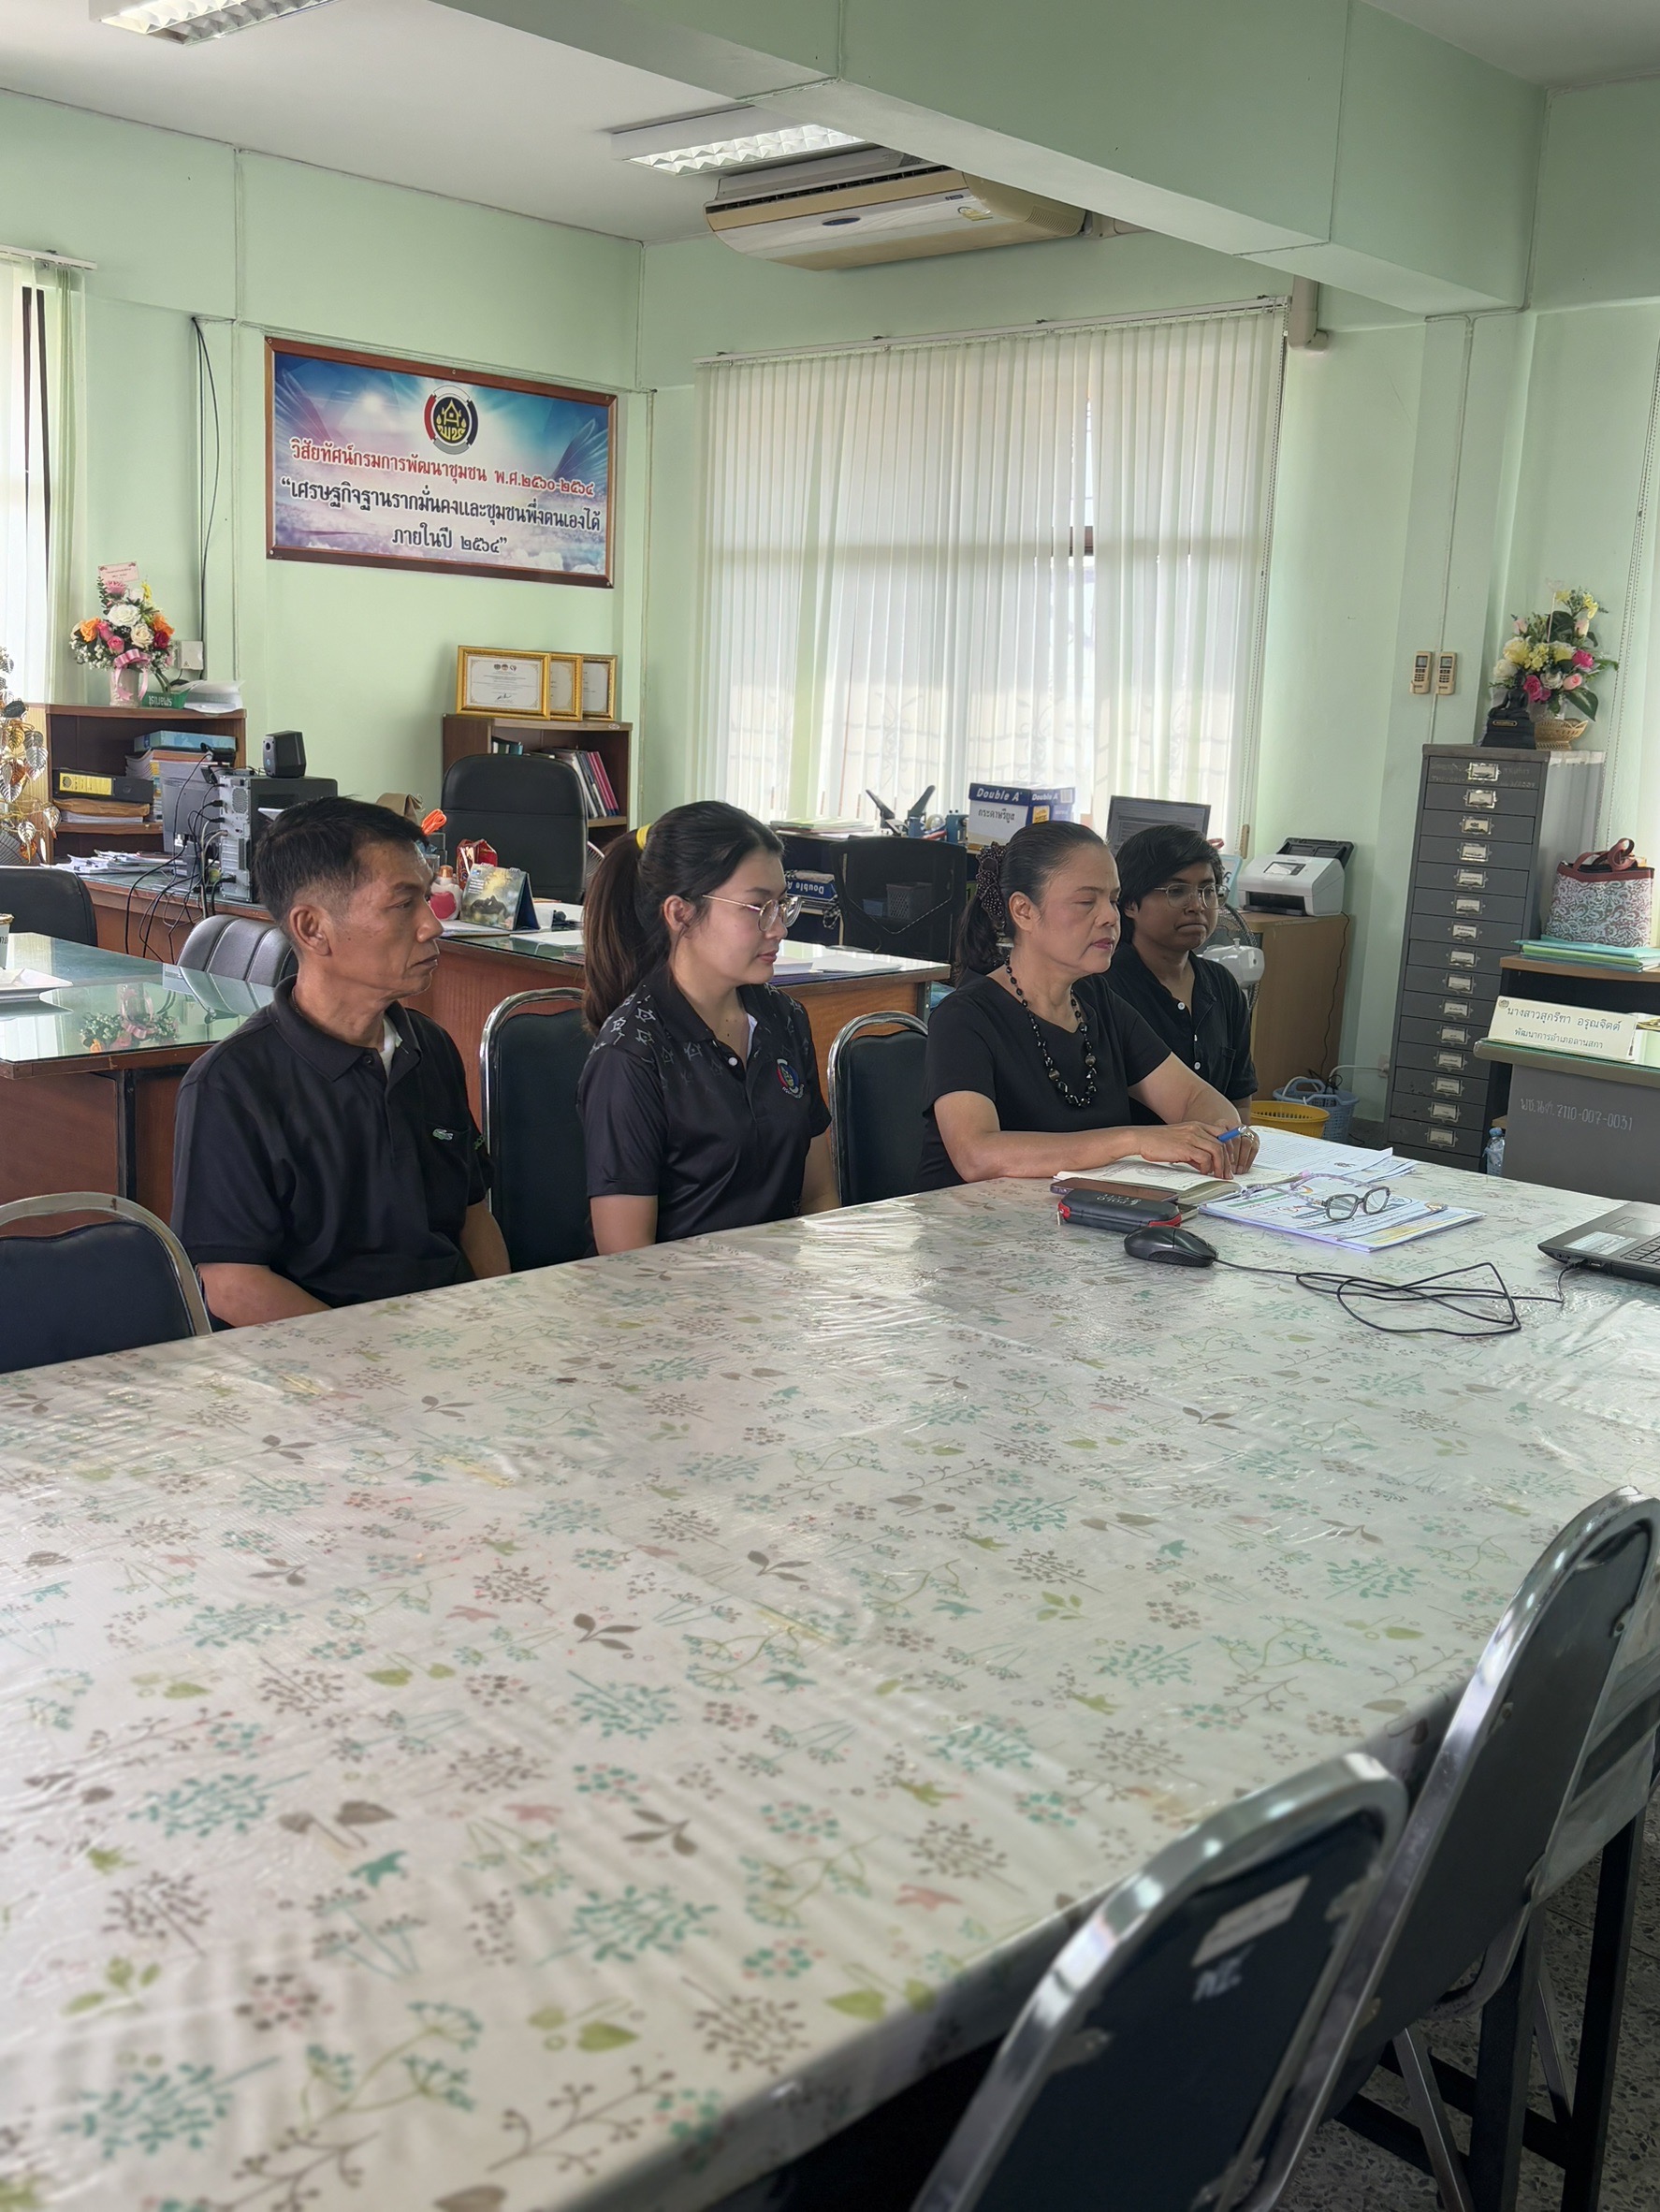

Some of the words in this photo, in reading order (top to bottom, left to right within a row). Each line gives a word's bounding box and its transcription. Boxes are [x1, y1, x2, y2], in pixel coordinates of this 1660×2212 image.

[290, 438, 487, 484] วิสัยทัศน์กรมการพัฒนาชุมชน
[494, 470, 594, 496] พ.ศ.๒๕๖๐-๒๕๖๔
[281, 477, 601, 531] “เศรษฐกิจฐานรากมั่นคงและชุมชนพึ่งตนเองได้
[392, 522, 453, 548] ภายในปี
[976, 788, 1010, 800] Double
[1012, 793, 1020, 802] A
